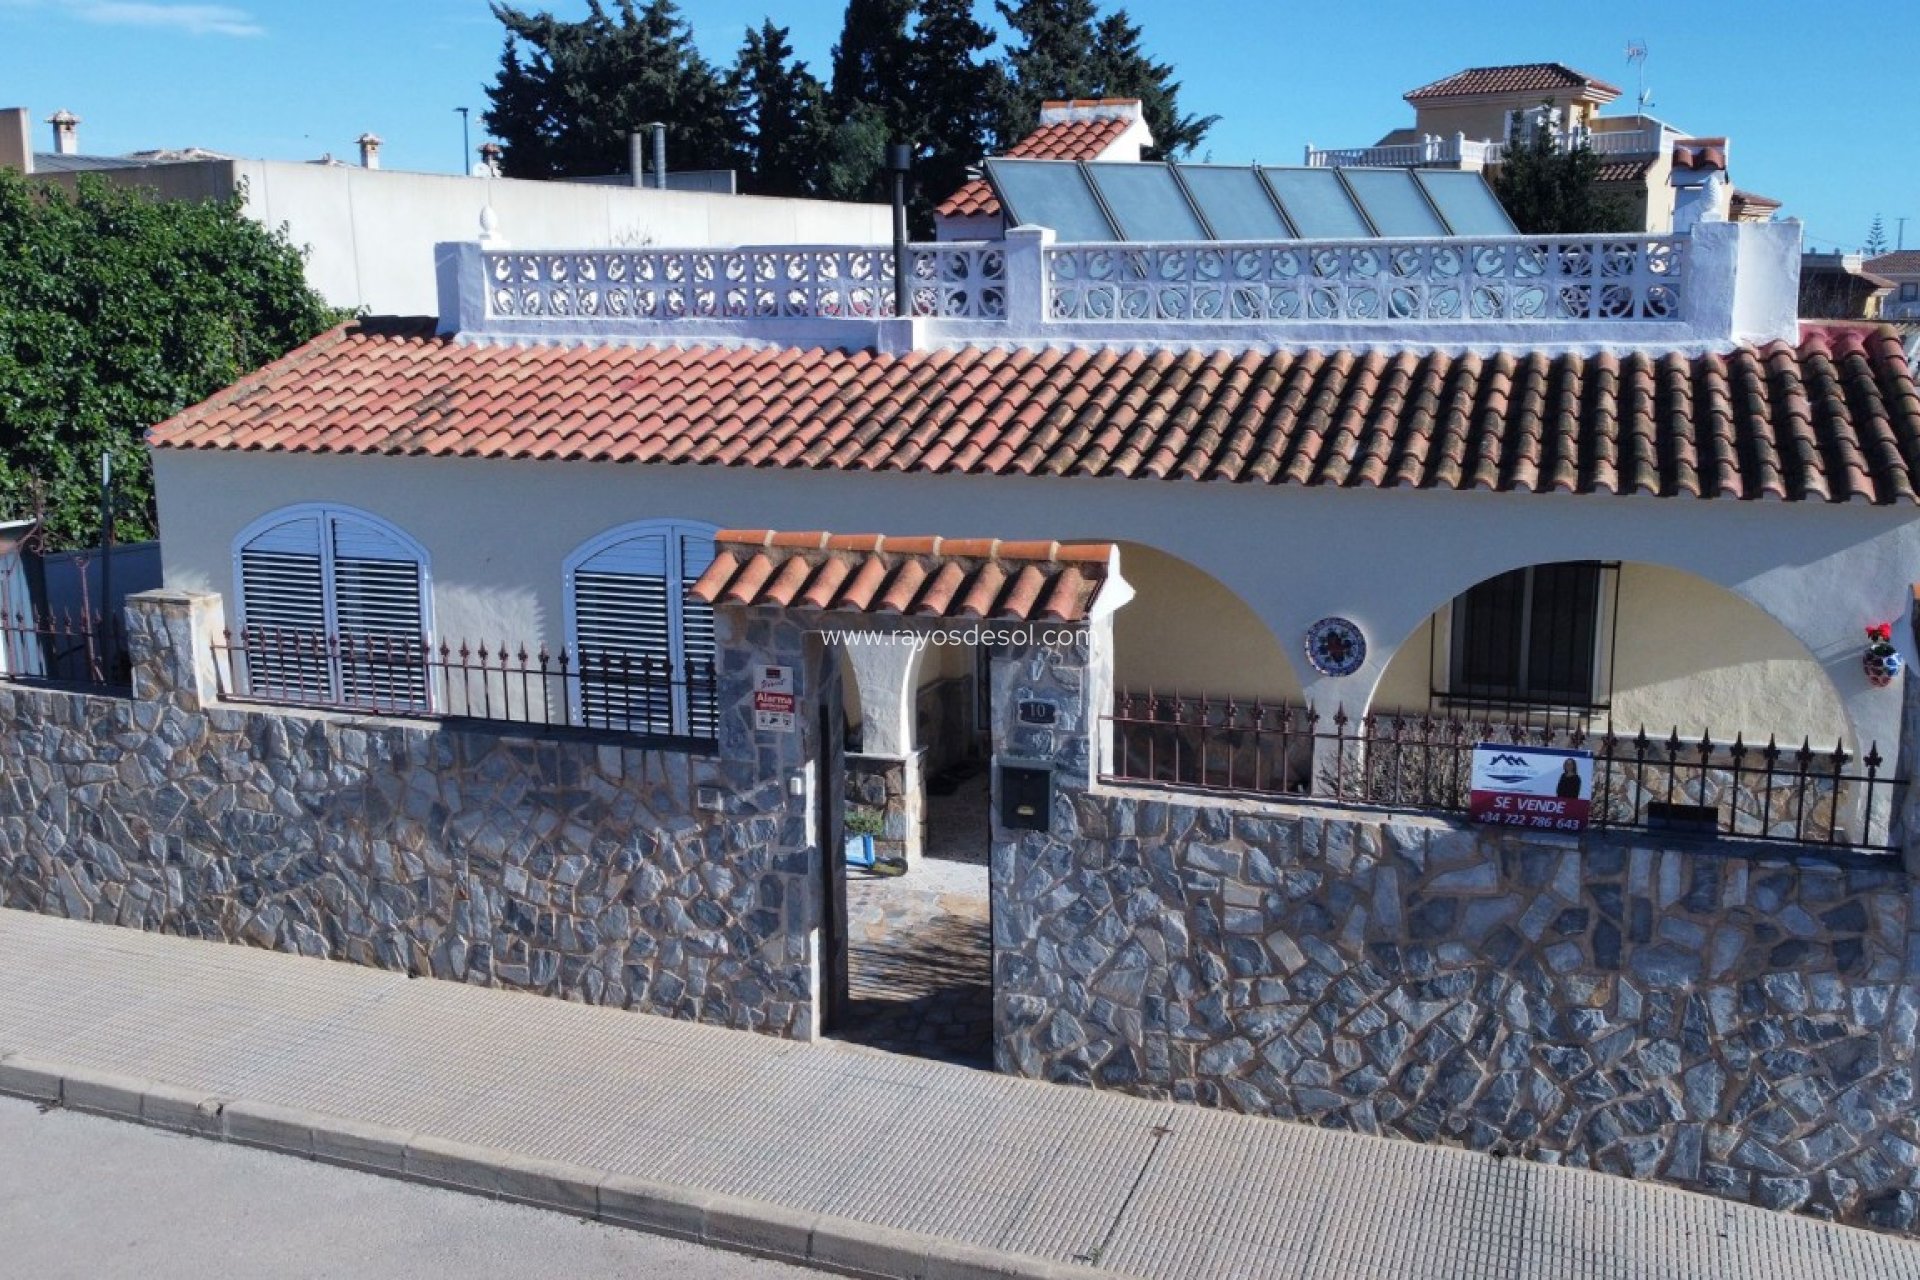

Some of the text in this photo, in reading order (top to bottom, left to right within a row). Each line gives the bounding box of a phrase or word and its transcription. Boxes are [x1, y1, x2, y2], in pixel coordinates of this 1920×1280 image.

[757, 692, 792, 705] Alarma
[1031, 703, 1046, 718] 10
[1494, 796, 1567, 814] SE VENDE
[1480, 811, 1580, 831] +34 722 786 643
